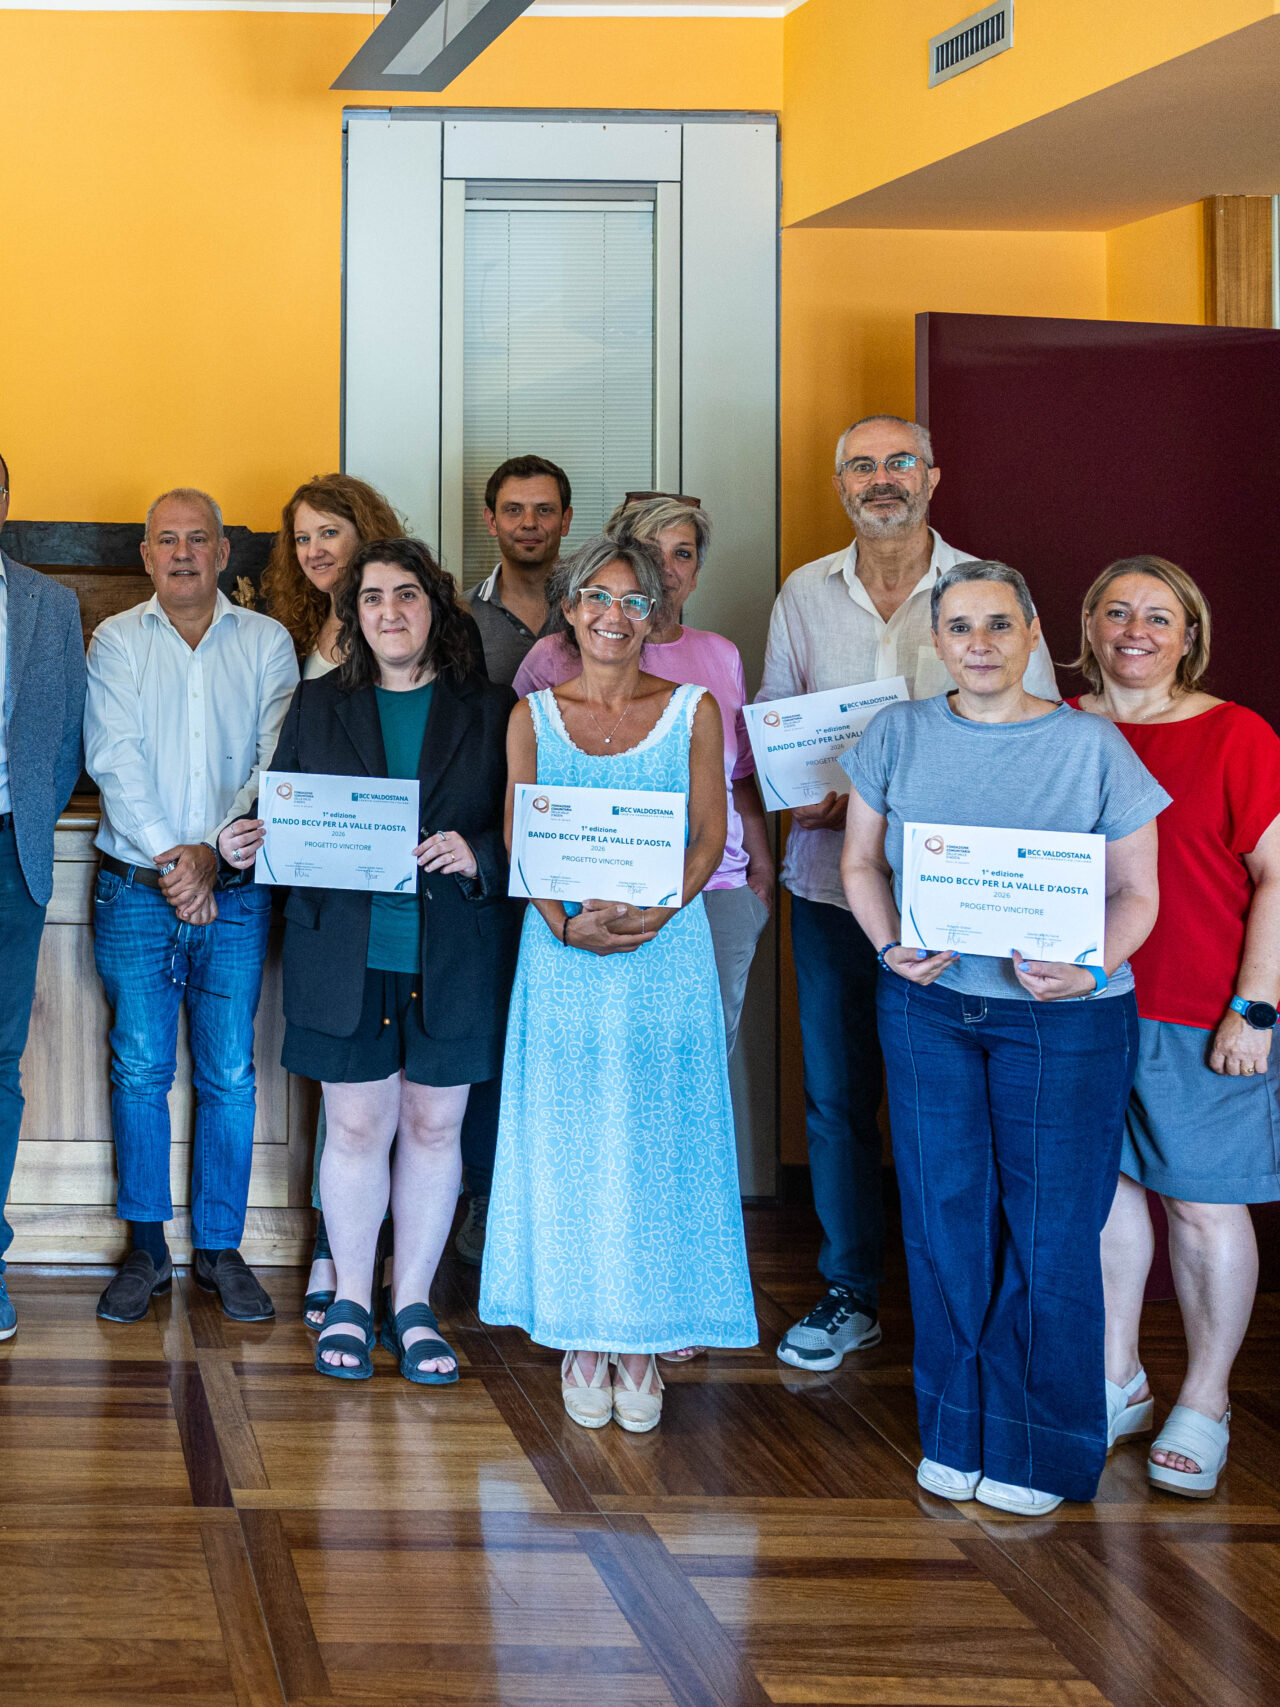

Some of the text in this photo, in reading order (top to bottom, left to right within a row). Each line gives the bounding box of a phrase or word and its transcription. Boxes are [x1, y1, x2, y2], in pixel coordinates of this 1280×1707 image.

[860, 695, 898, 706] VALDOSTANA
[823, 724, 850, 733] edizione
[768, 731, 863, 752] BANDO BCCV PER LA VAL
[374, 824, 406, 832] D'AOSTA
[528, 831, 557, 839] BANDO
[637, 839, 671, 847] D'AOSTA
[562, 855, 633, 866] PROGETTO VINCITORE
[1043, 851, 1091, 859] VALDOSTANA
[991, 870, 1024, 878] edizione
[920, 875, 953, 883] BANDO
[983, 879, 999, 888] PER
[1002, 881, 1013, 889] LA
[1016, 882, 1044, 891] VALLE
[1048, 885, 1088, 894] D'AOSTA
[960, 902, 1044, 915] PROGETTO VINCITORE
